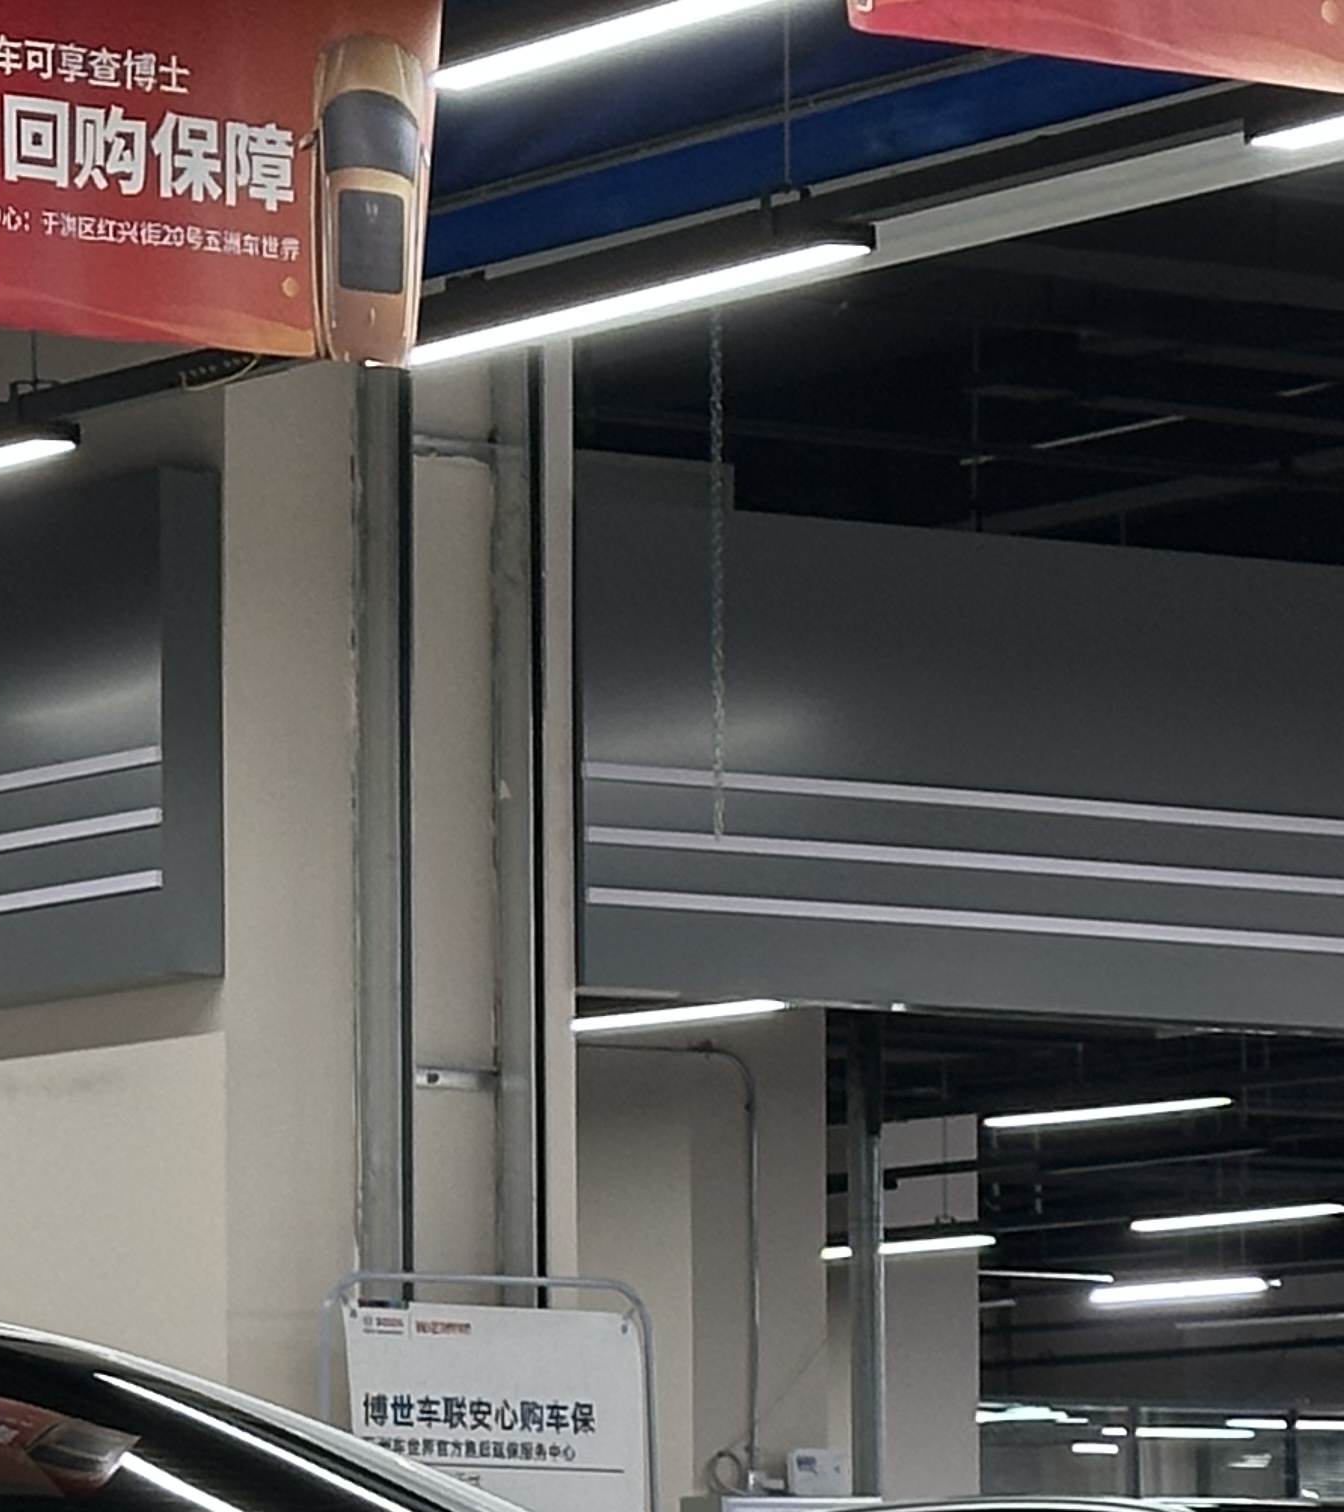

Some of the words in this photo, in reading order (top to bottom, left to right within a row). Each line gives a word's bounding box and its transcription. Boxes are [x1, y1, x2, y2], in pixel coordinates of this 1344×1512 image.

[363, 1393, 596, 1434] 博世车联安心购车保
[364, 1437, 576, 1461] 车世界官方售后延保服务中心
